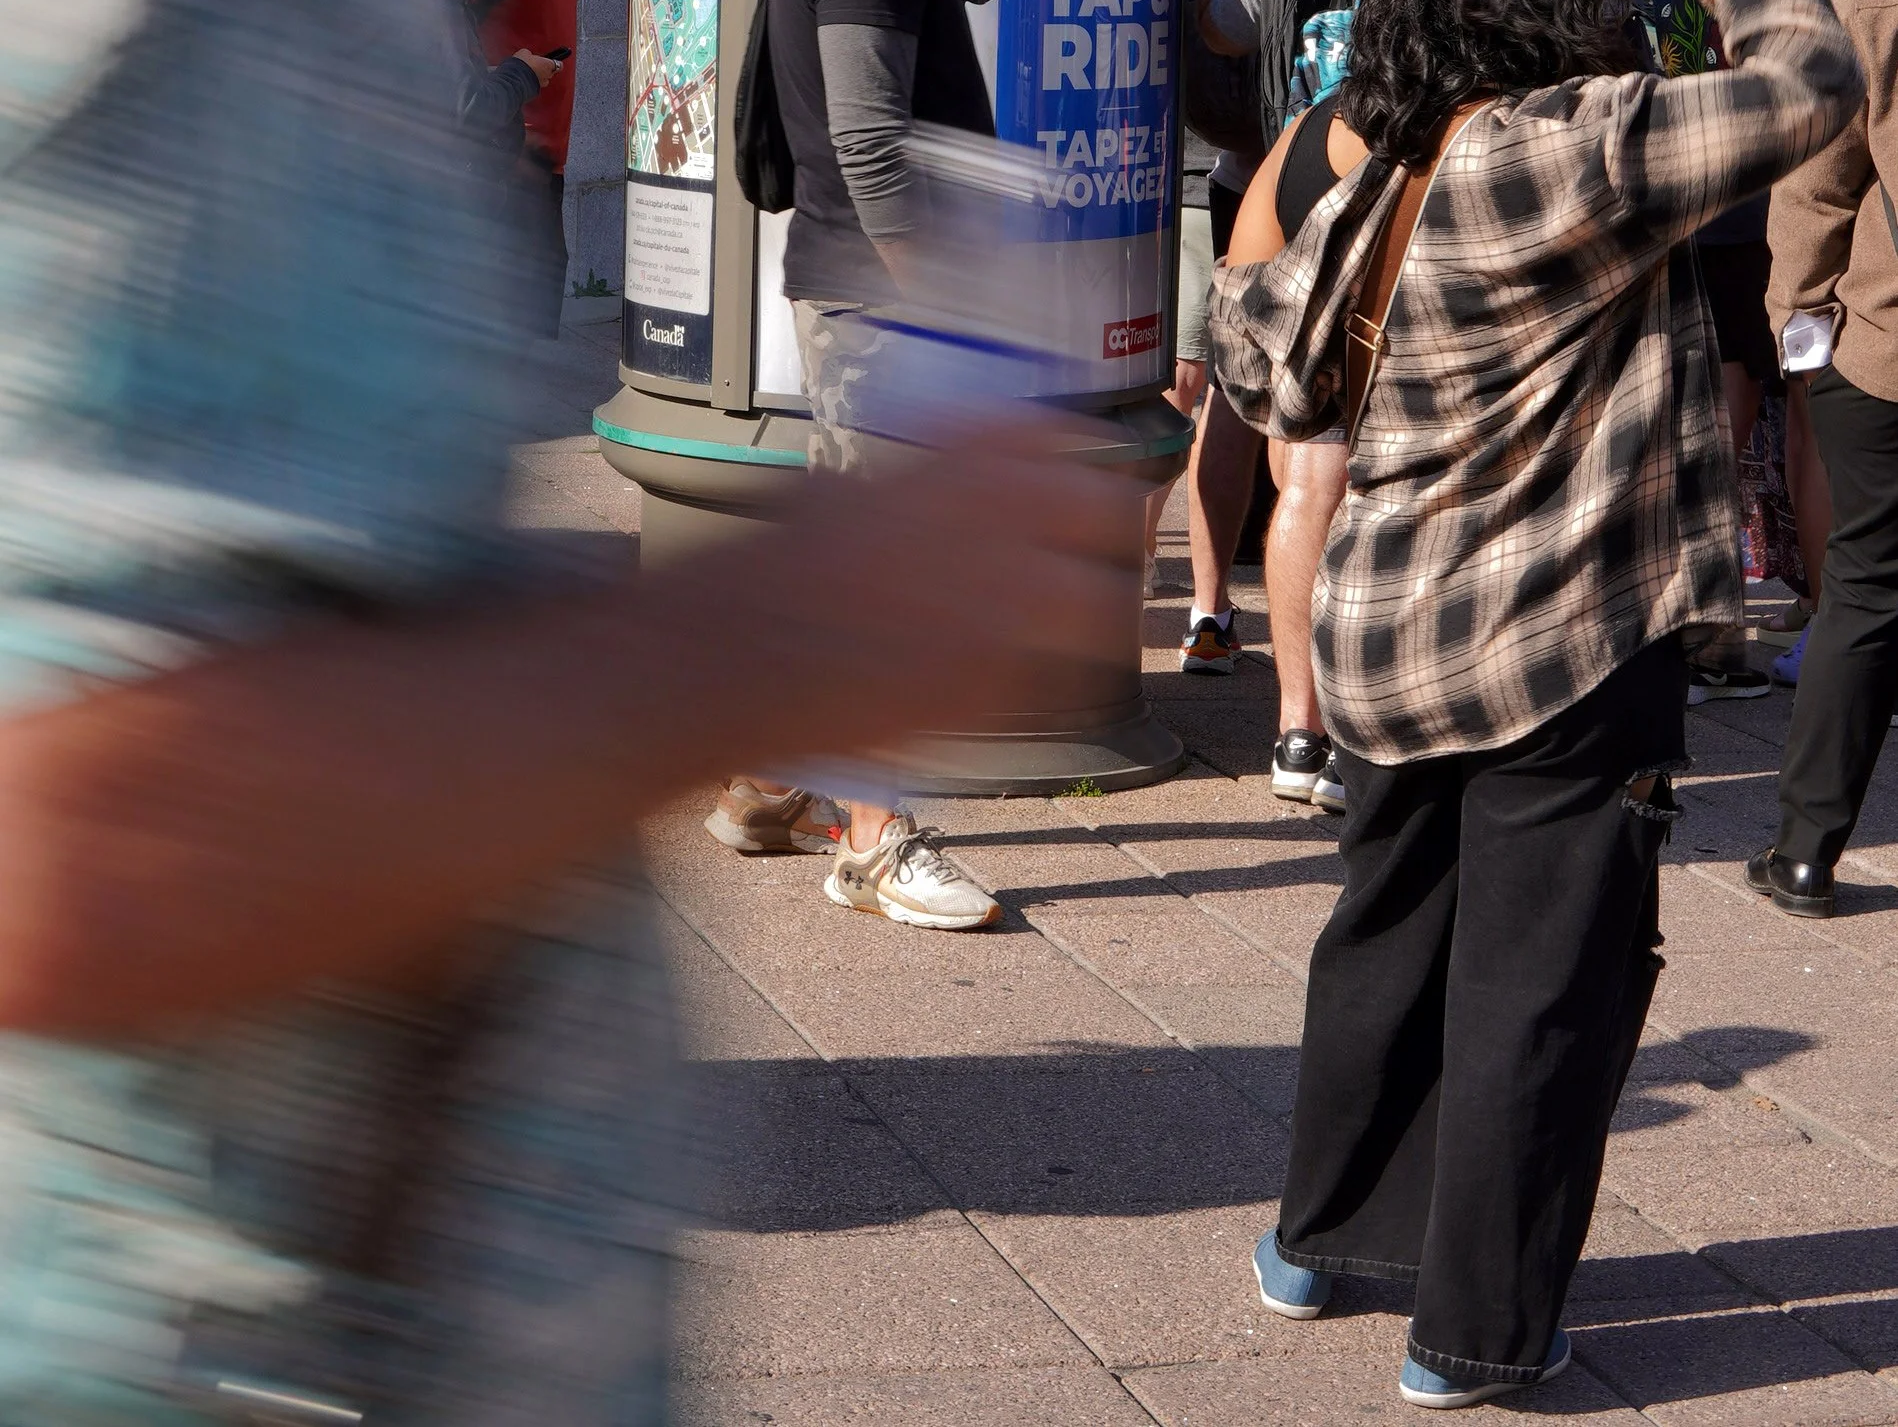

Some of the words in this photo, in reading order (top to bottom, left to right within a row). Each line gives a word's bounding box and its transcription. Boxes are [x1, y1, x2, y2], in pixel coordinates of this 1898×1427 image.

[1042, 21, 1169, 91] RIDE
[1037, 126, 1150, 169] TAPEZ
[1038, 166, 1165, 209] VOYAGEZ
[643, 319, 685, 347] Canada
